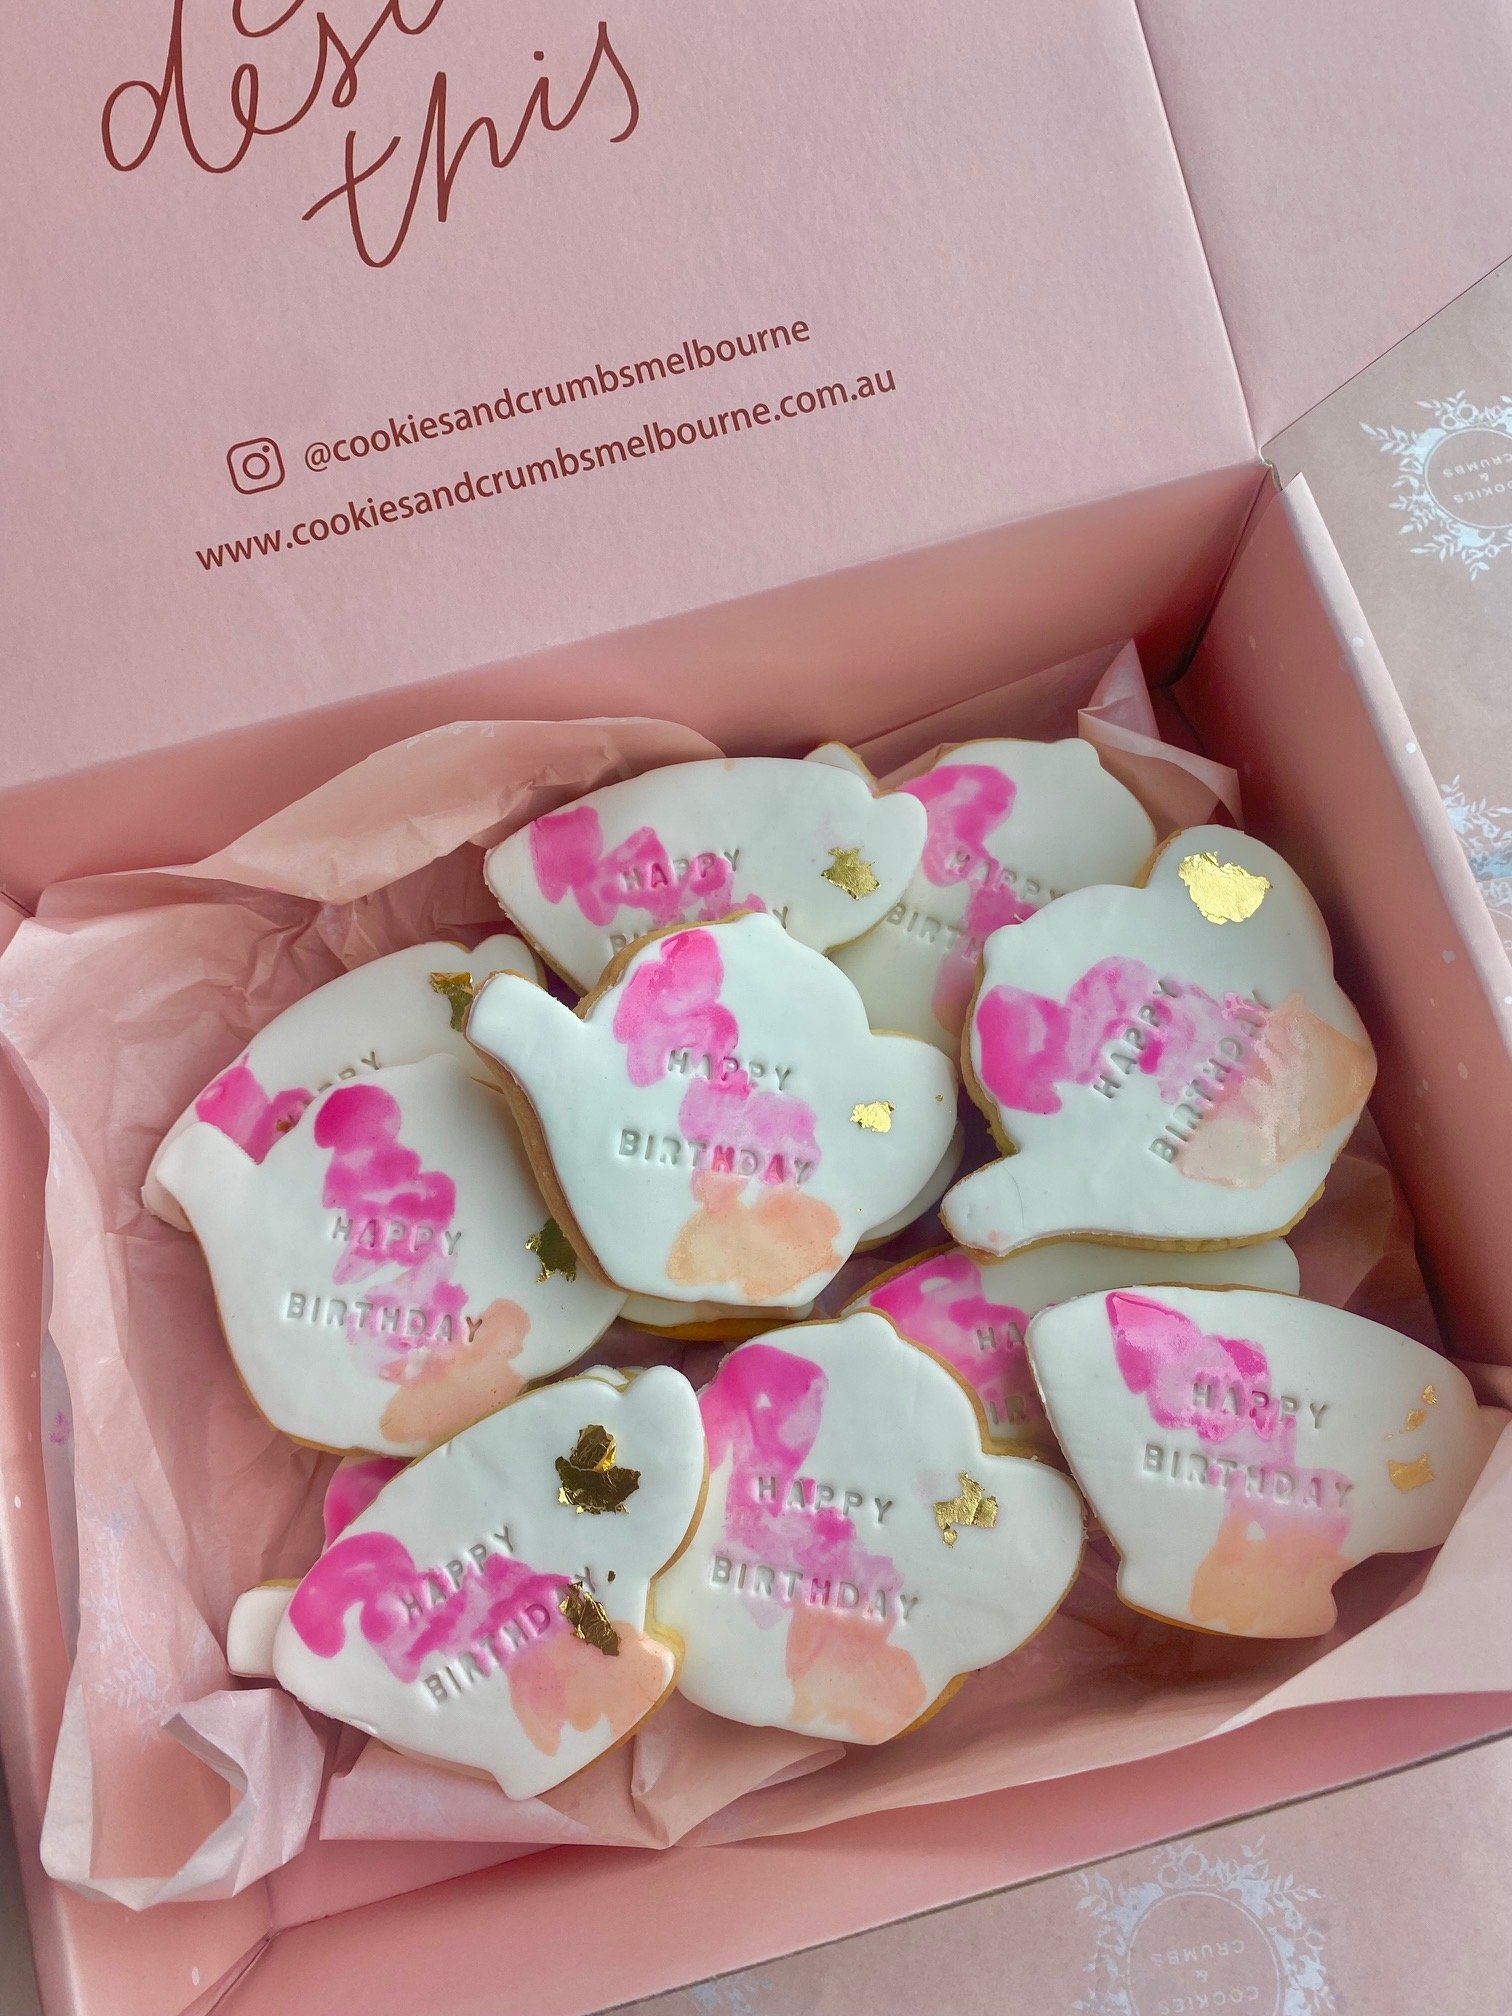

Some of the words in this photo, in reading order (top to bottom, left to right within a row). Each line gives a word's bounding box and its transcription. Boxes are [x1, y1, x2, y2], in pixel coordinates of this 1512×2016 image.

[302, 21, 639, 268] this
[304, 320, 810, 473] @cookiesandcrumbsmelbourne
[195, 369, 896, 571] www.cookiesandcrumbsmelbourne.com.au
[620, 848, 740, 891] HAPPY
[946, 848, 1058, 902] HAPP
[886, 902, 984, 963] BIRTH
[1093, 979, 1178, 1099] HAPPY
[668, 1049, 792, 1091] HAPPY
[618, 1128, 811, 1184] BIRTHDAY
[332, 1216, 462, 1256] HAPPY
[286, 1292, 483, 1342] BIRTHDAY
[1192, 1382, 1328, 1429] HAPPY
[758, 1476, 893, 1523] HAPPY
[1143, 1443, 1355, 1508] BIRTHDAY
[401, 1526, 514, 1621] HAPPY
[711, 1556, 919, 1621] BIRTHDAY
[423, 1566, 596, 1704] BIRTHDY
[1150, 1939, 1245, 1967] CRUMBS
[1159, 1985, 1259, 2016] COOKIES
